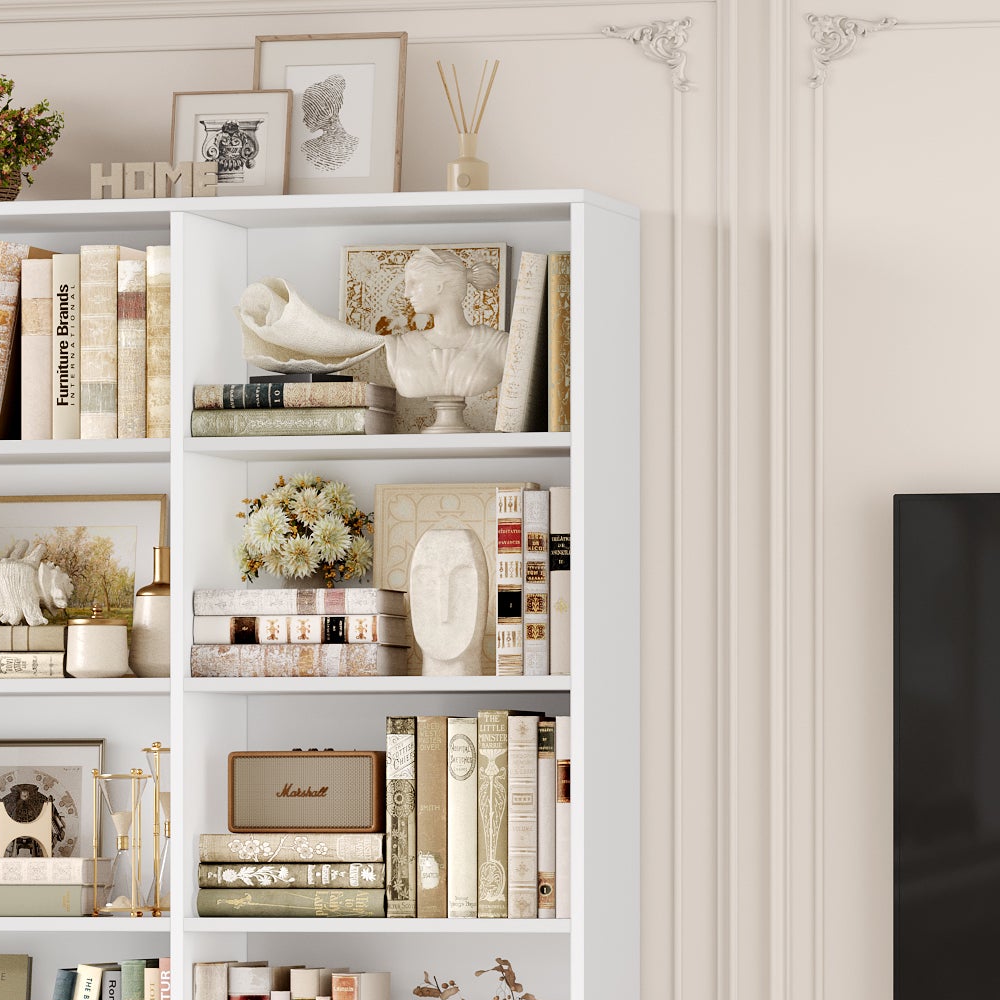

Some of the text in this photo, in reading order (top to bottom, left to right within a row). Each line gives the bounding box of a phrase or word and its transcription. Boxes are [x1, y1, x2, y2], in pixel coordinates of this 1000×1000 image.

[90, 162, 218, 200] HOME
[56, 284, 69, 406] Furniture Brands
[484, 714, 500, 723] THE
[480, 724, 505, 732] LITTLE
[479, 733, 508, 742] MINISTER
[276, 783, 329, 798] Marshall
[84, 978, 93, 993] THE
